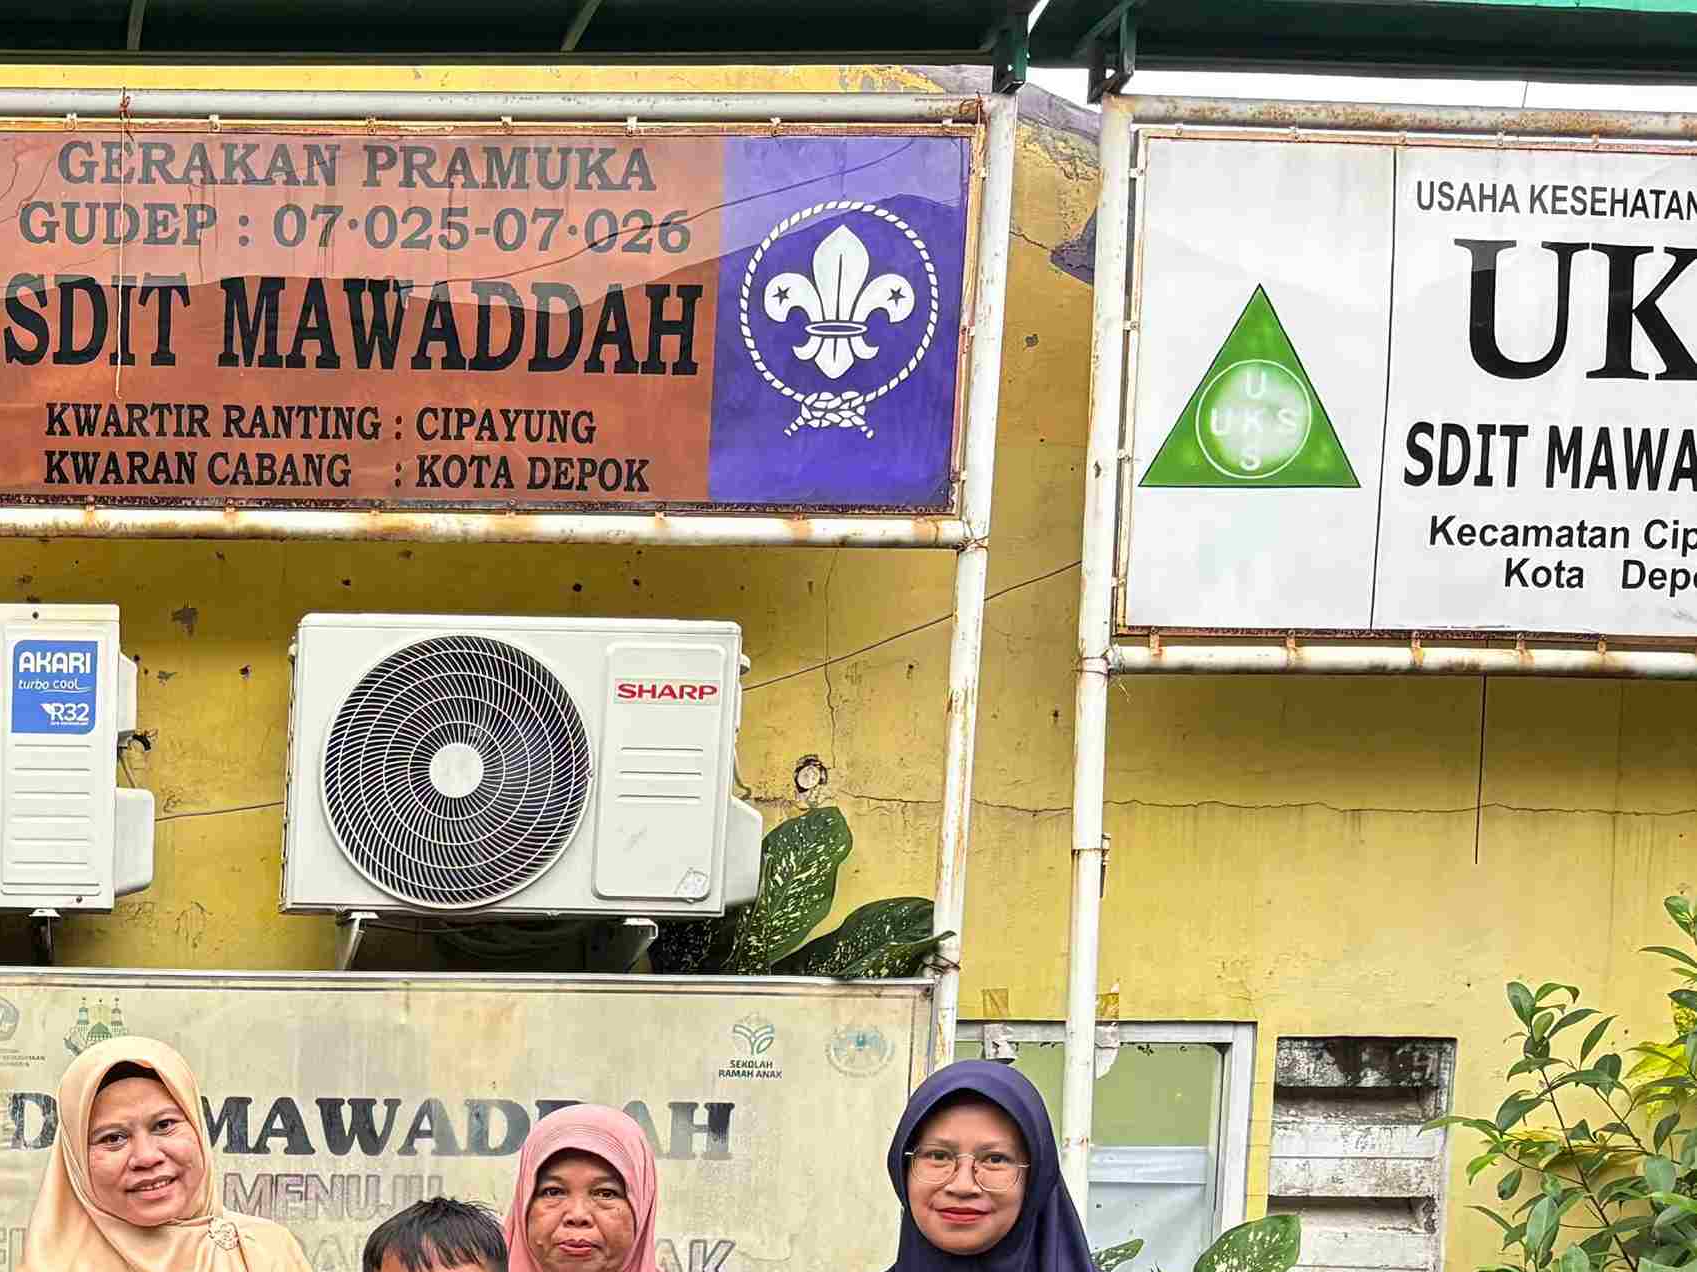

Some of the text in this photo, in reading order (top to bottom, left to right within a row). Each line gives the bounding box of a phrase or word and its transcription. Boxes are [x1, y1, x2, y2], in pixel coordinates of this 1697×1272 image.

[57, 140, 657, 192] GERAKAN PRAMUKA
[1415, 179, 1521, 214] USAHA
[19, 201, 218, 248] GUDEP
[3, 273, 704, 377] SDIT MAWADDAH
[44, 402, 212, 439] KWARTIR
[222, 404, 381, 441] RANTING
[414, 406, 597, 445] CIPAYUNG
[43, 450, 198, 487] KWARAN
[206, 451, 353, 488] CABANG
[414, 454, 515, 490] KOTA
[526, 456, 651, 494] DEPOK
[1403, 421, 1529, 488] SDIT
[1429, 514, 1631, 549] Kecamatan
[1504, 557, 1697, 598] Kota Dep
[17, 651, 92, 675] AKARI
[17, 678, 80, 691] turbo cool
[616, 682, 718, 700] SHARP
[49, 702, 90, 722] R32
[718, 1069, 753, 1078] RAMAH
[729, 1060, 774, 1069] SEKOLAH
